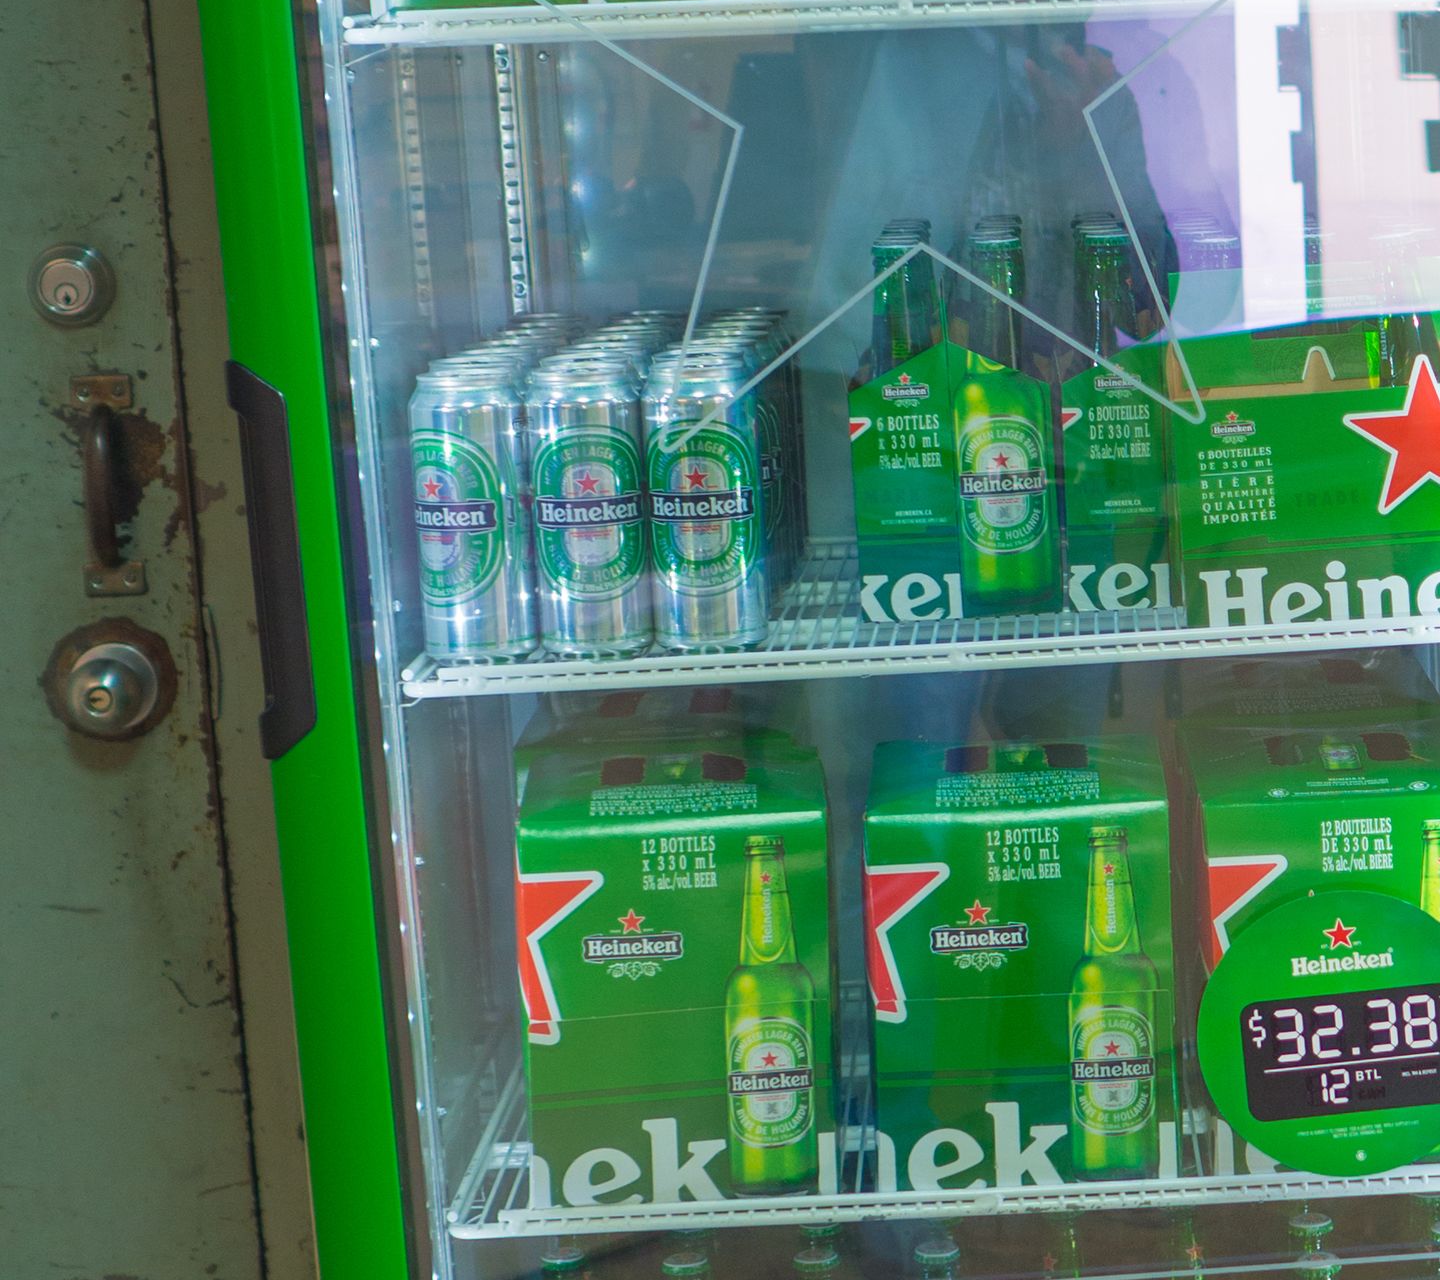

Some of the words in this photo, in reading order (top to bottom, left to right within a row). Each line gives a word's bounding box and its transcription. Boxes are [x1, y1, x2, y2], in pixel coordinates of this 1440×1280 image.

[885, 386, 927, 396] Heineken
[1088, 410, 1095, 421] 6
[1096, 405, 1149, 421] BOUTEILLES
[877, 418, 884, 431] 6
[888, 414, 939, 431] BOTTLES
[1090, 425, 1103, 440] DE
[1109, 424, 1129, 439] 330
[892, 434, 915, 449] 330
[922, 452, 942, 468] BEER
[1208, 447, 1271, 459] BOUTEILLES
[1223, 461, 1248, 469] 330
[963, 476, 1042, 493] Heineken
[1201, 475, 1274, 489] BIÈRE
[1220, 487, 1274, 498] PREMIÈRE
[541, 500, 638, 523] Heineken
[653, 493, 747, 517] Heineken
[1202, 498, 1275, 513] QUALITÉ
[1204, 510, 1276, 524] IMPORTÉE
[1321, 821, 1332, 836] 12
[1335, 817, 1392, 836] BOUTEILLES
[642, 839, 655, 854] 12
[660, 836, 715, 853] BOTTLES
[987, 830, 1000, 846] 12
[1005, 827, 1059, 844] BOTTLES
[1322, 838, 1338, 853] DE
[1344, 837, 1369, 852] 330
[1375, 834, 1392, 850] mL
[658, 855, 687, 871] 330
[695, 853, 715, 869] mL
[1003, 846, 1031, 863] 330
[1039, 844, 1060, 861] mL
[1369, 851, 1393, 869] BIÈRE
[694, 872, 717, 888] BEER
[1039, 863, 1061, 879] BEER
[1106, 879, 1116, 934] Heineken
[762, 888, 773, 944] Heineken
[588, 938, 678, 957] Heineken
[935, 929, 1024, 948] Heineken
[1292, 952, 1393, 976] Heineken
[1249, 994, 1439, 1063] $32.38
[1075, 1062, 1150, 1078] Heineken
[732, 1073, 809, 1091] Heineken
[1321, 1068, 1350, 1104] 12
[1356, 1069, 1381, 1082] BTL
